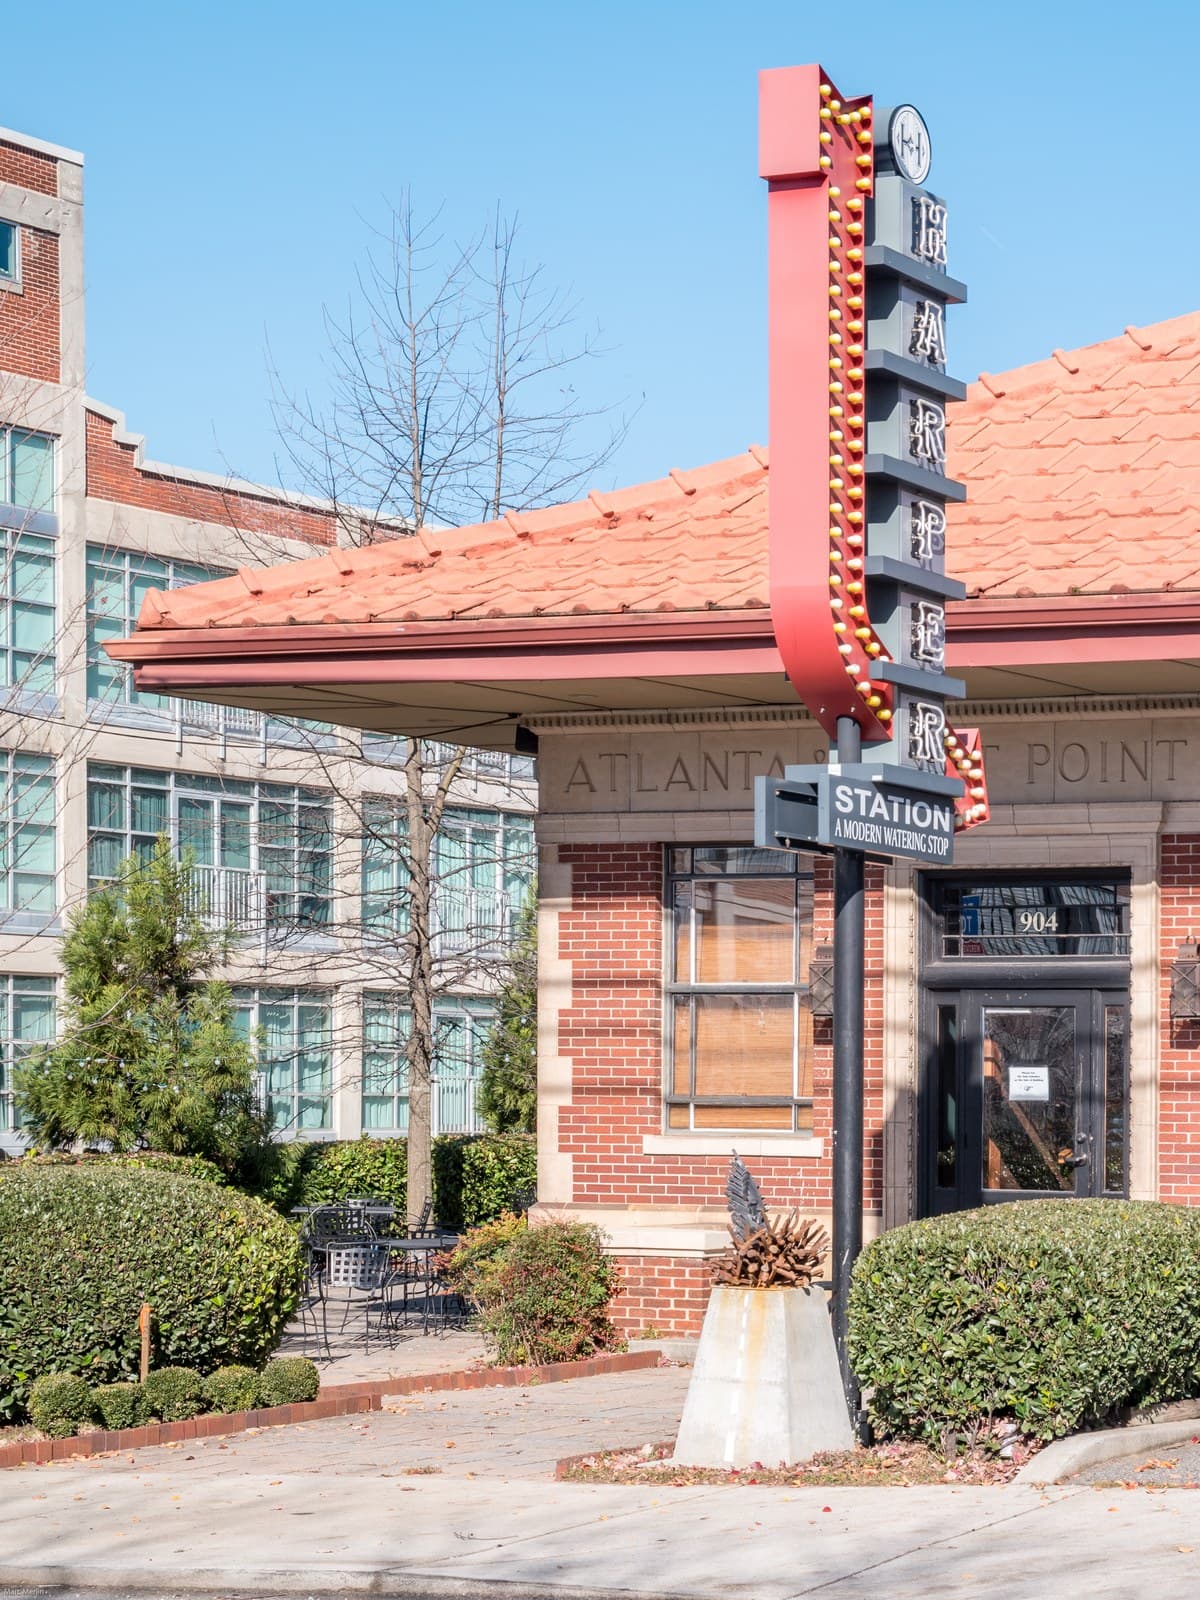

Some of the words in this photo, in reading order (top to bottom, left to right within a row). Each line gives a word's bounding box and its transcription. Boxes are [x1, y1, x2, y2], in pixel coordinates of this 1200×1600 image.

[914, 196, 948, 763] HARPER
[1025, 738, 1188, 784] POINT
[835, 785, 950, 832] STATION
[834, 817, 842, 837] A
[843, 818, 882, 844] MODERN
[883, 826, 926, 853] WATERING
[928, 836, 949, 856] STOP
[1020, 911, 1058, 932] 904
